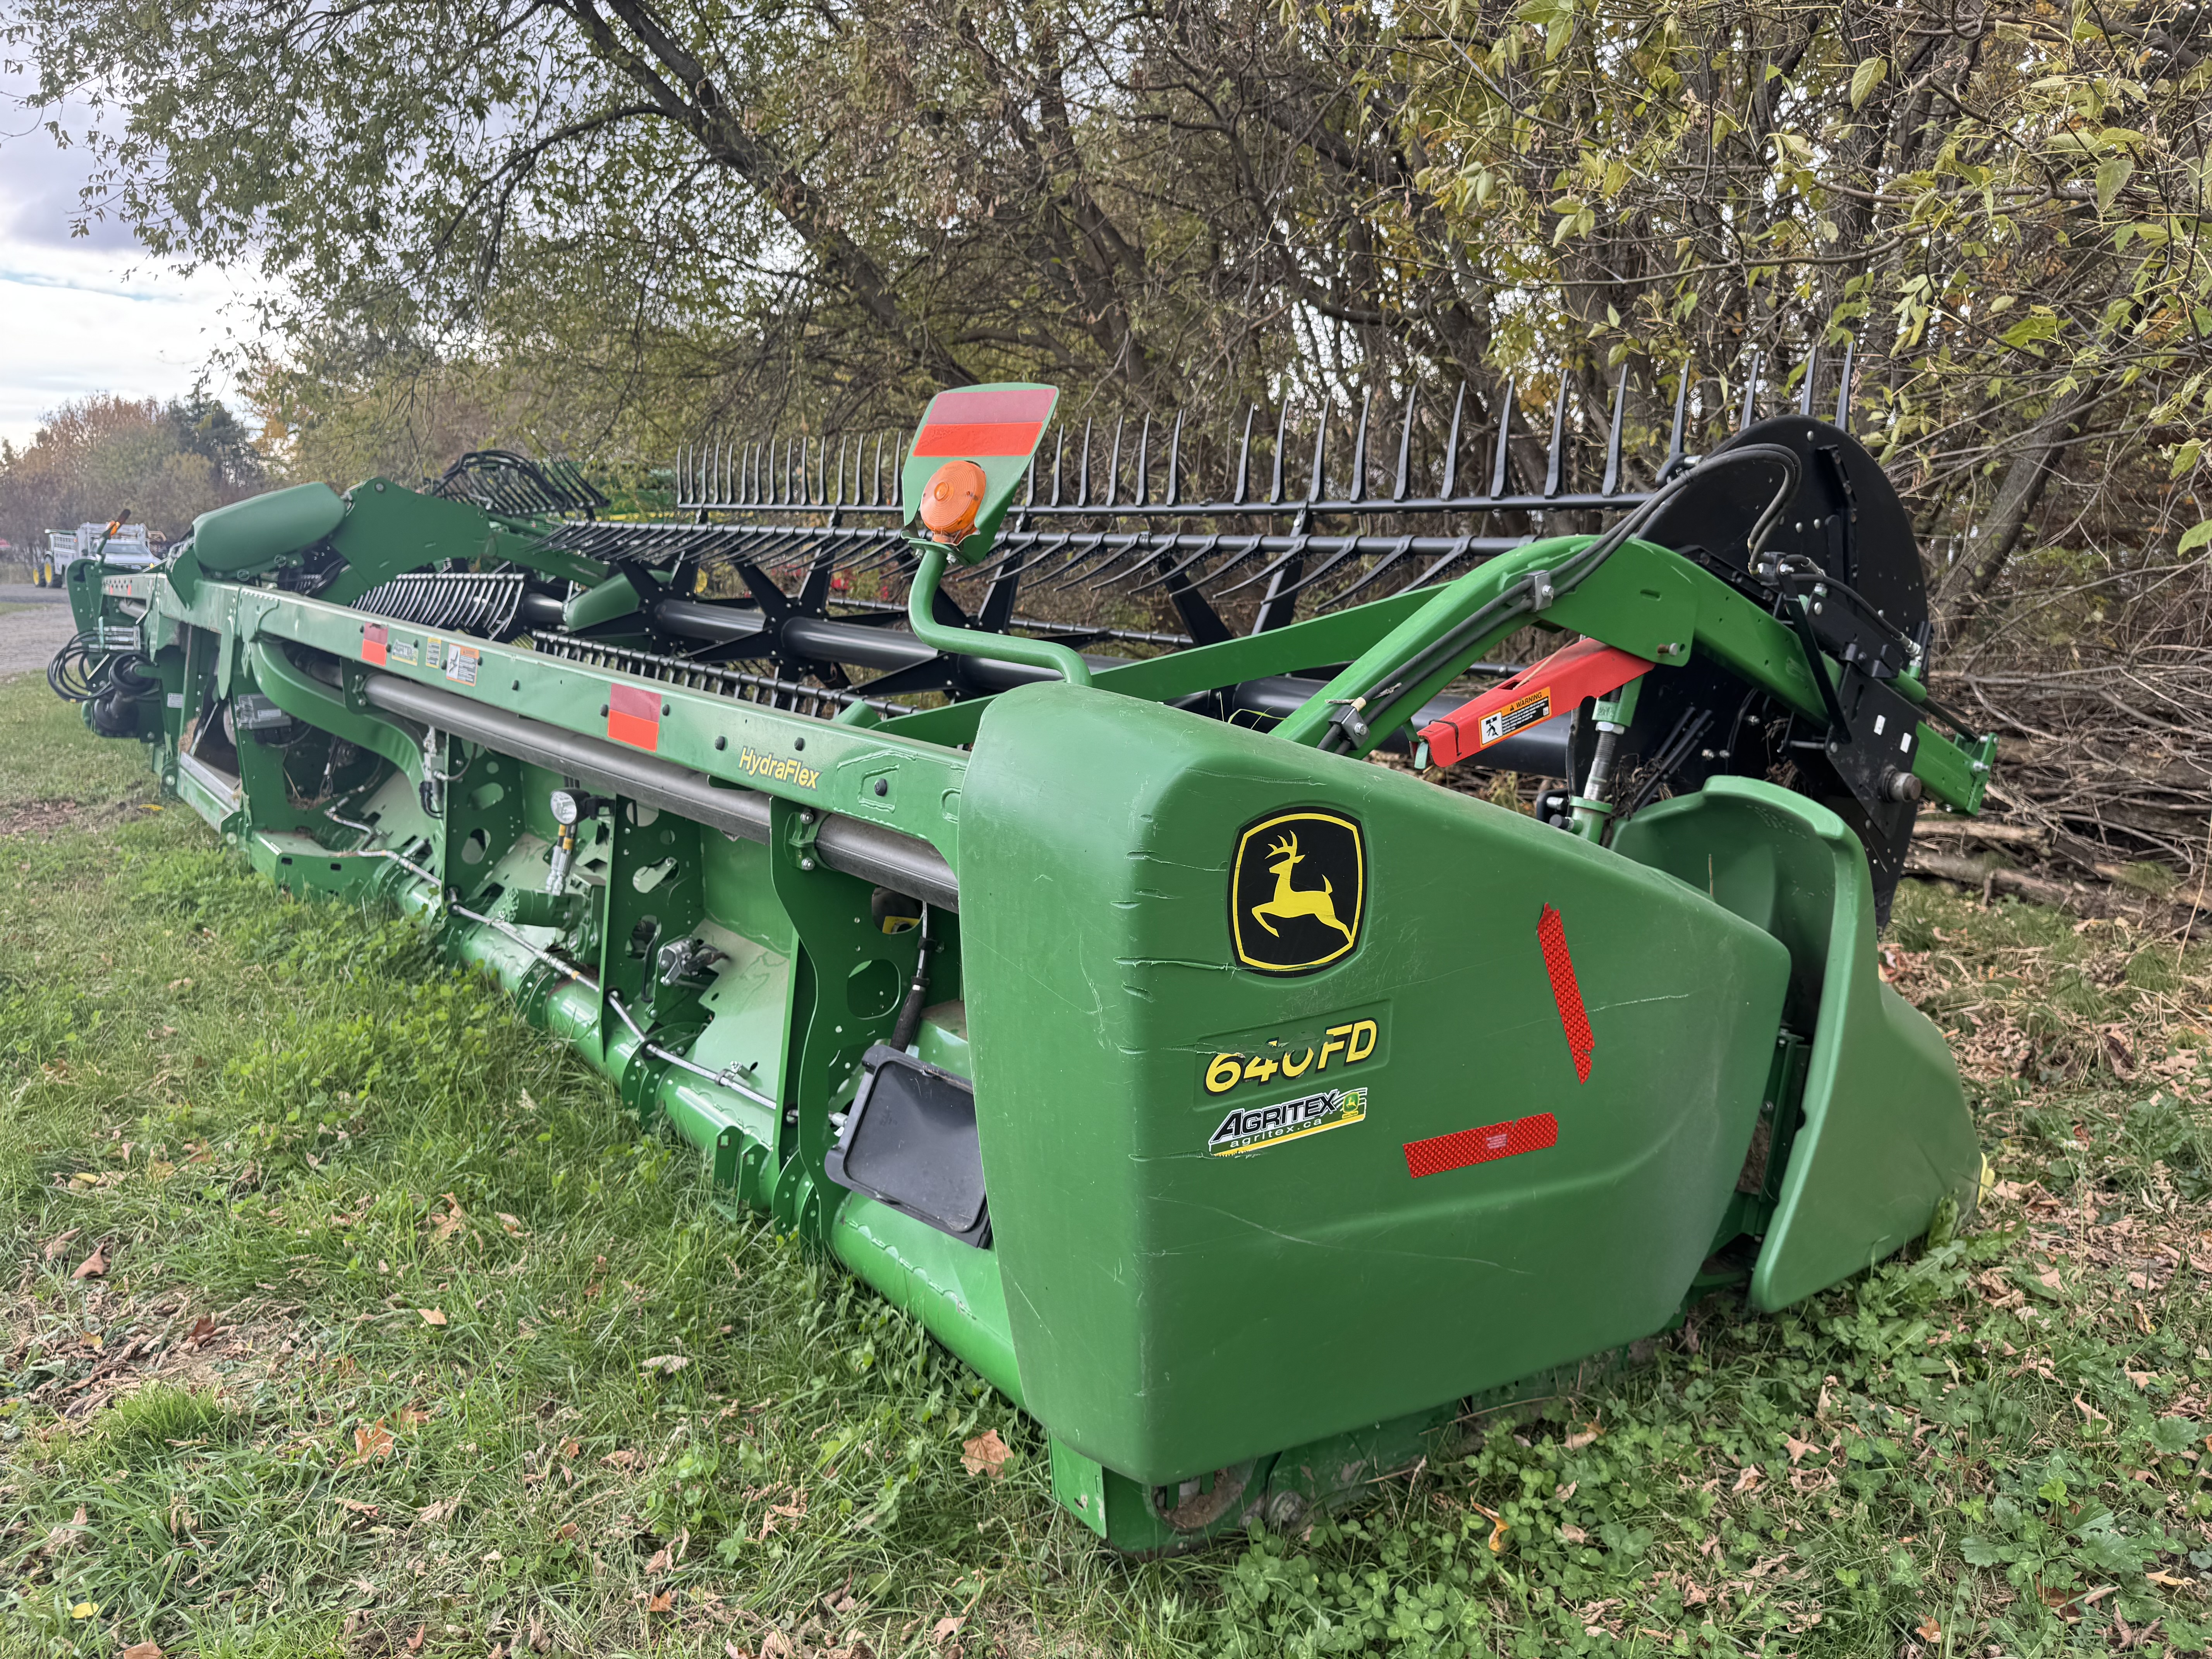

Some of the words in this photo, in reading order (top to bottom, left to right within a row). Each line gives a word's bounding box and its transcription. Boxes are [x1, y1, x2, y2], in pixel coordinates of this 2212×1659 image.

[1516, 692, 1542, 708] WARNING
[738, 746, 821, 790] HydraFlex
[1210, 1089, 1338, 1144] AGRITEX
[1230, 1118, 1322, 1148] agritex.ca
